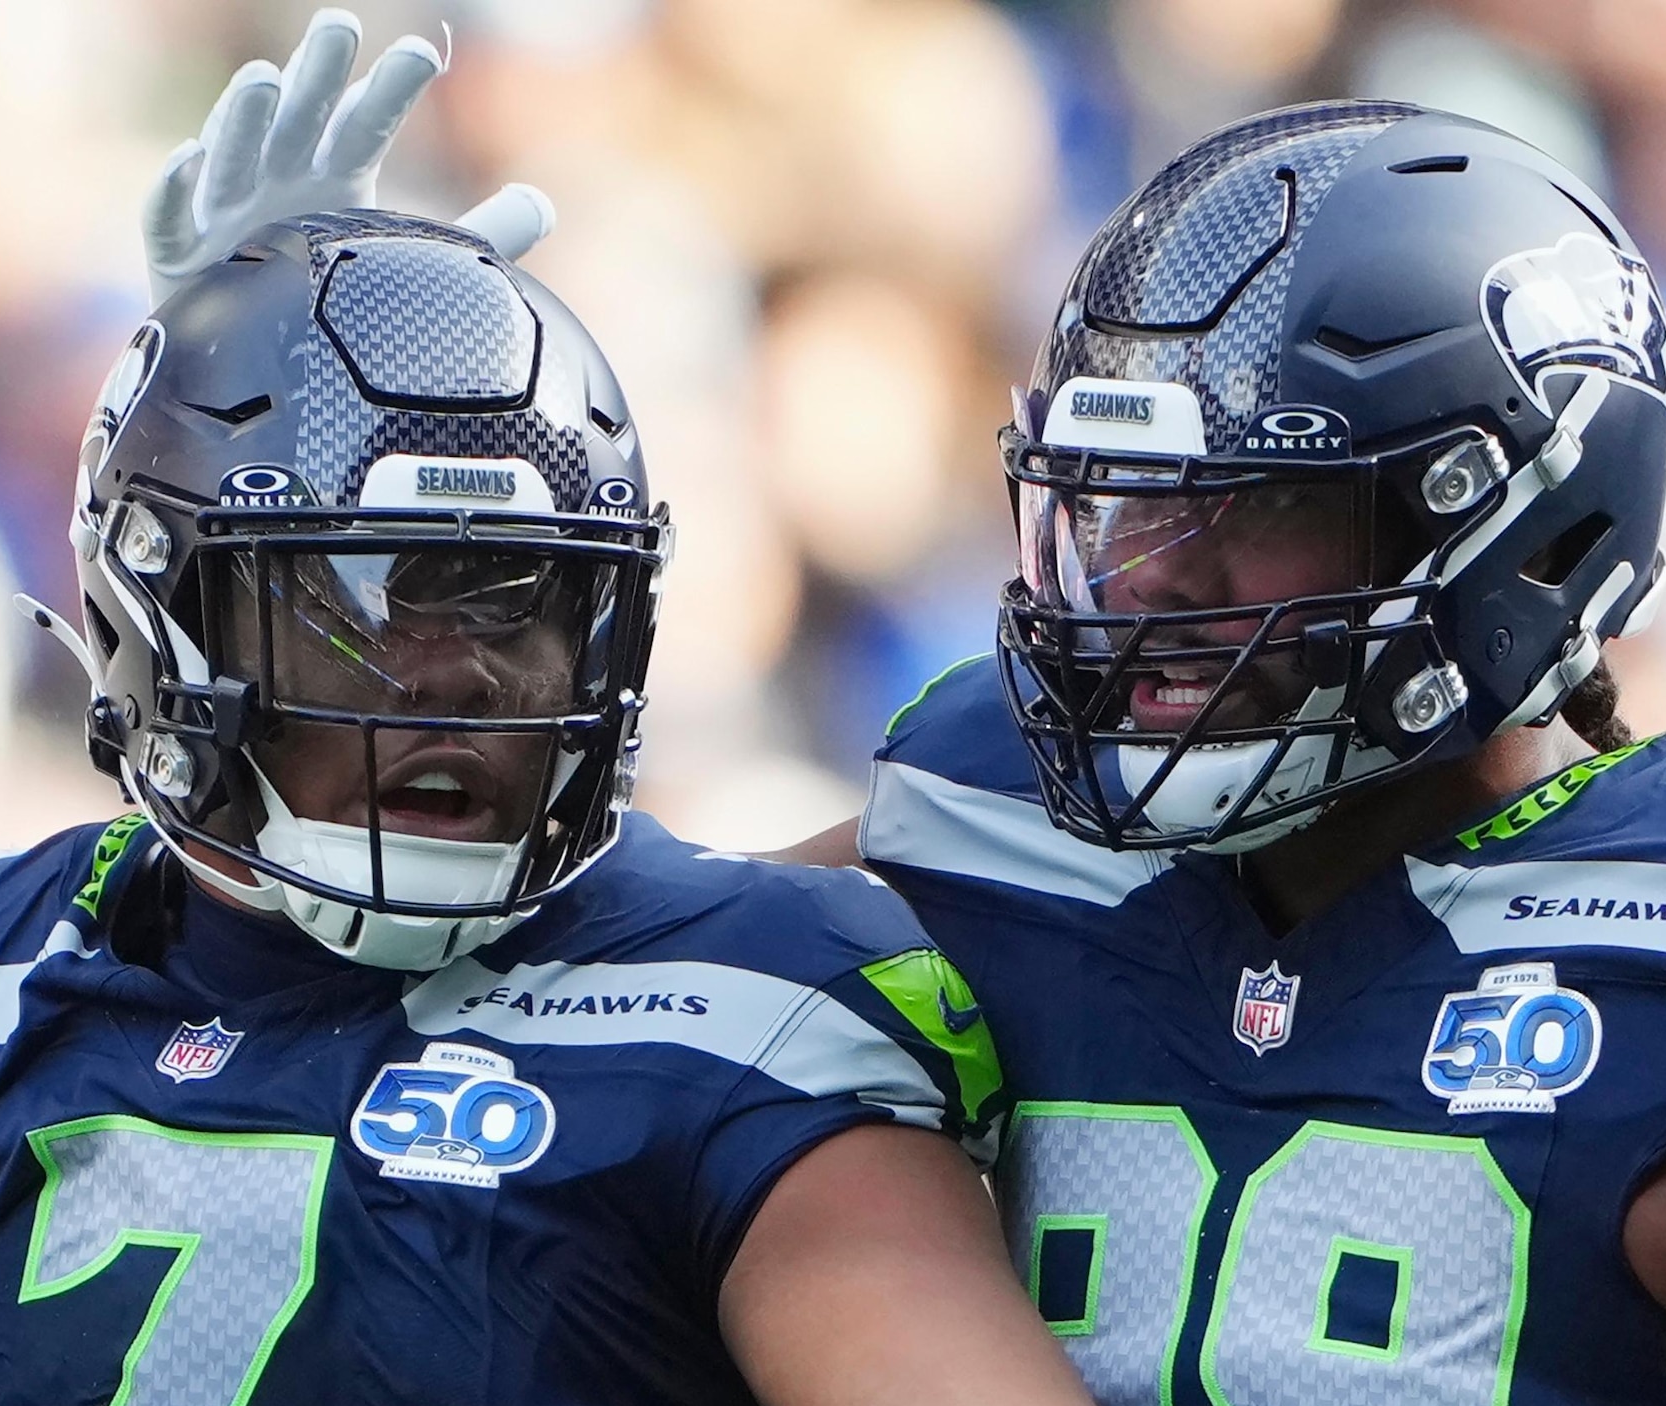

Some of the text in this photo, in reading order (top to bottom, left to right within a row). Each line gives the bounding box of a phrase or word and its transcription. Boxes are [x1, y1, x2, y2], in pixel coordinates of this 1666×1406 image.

[1070, 391, 1154, 424] SEAHAWKS
[1247, 437, 1342, 449] OAKLEY
[416, 466, 516, 497] SEAHAWKS
[220, 494, 305, 507] OAKLEY
[1493, 974, 1512, 985] EST
[457, 987, 709, 1016] SEAHAWKS
[1242, 1001, 1281, 1039] NFL
[168, 1043, 215, 1070] NFL
[1428, 994, 1593, 1092] 50
[440, 1051, 497, 1068] EST 1976
[359, 1069, 548, 1166] 50
